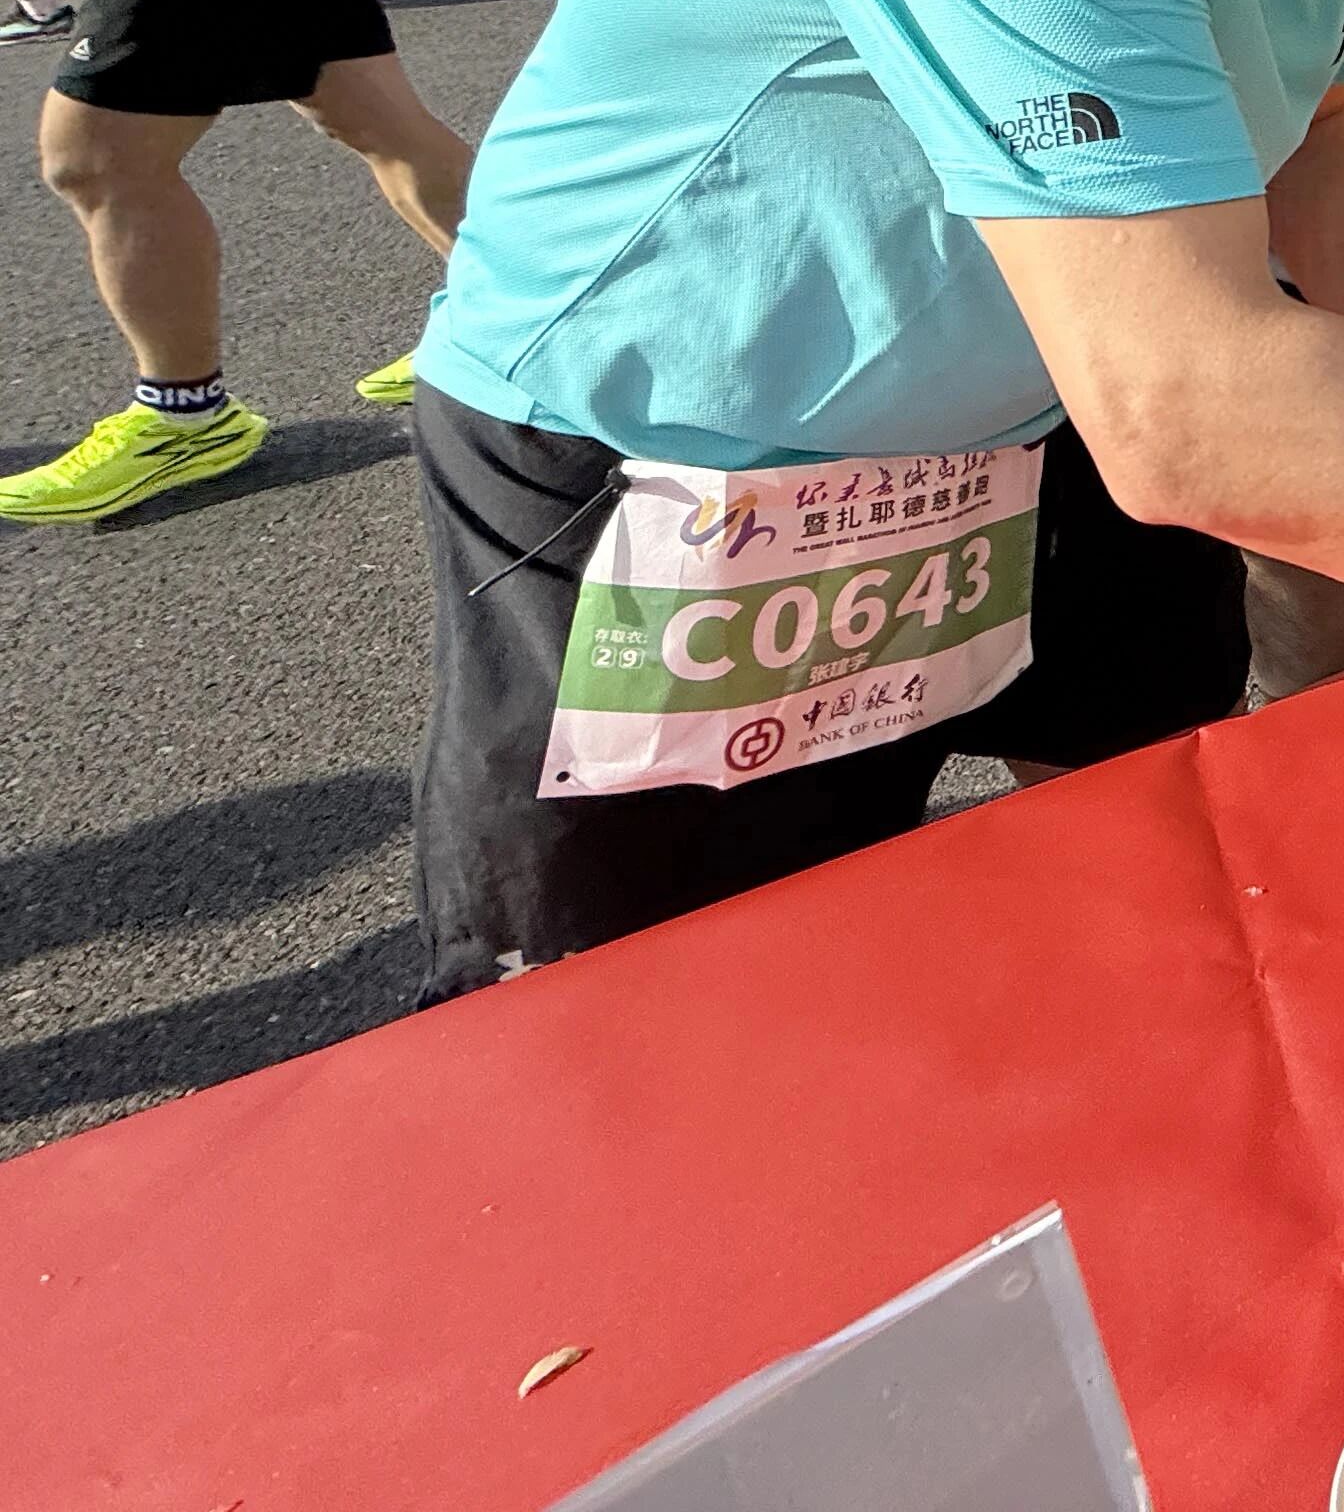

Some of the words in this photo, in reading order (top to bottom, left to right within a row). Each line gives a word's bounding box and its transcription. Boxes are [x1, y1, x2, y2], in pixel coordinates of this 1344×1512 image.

[1016, 93, 1066, 117] THE
[984, 110, 1069, 140] NORTH
[1008, 129, 1071, 156] FACE
[661, 536, 993, 682] C0643
[798, 727, 846, 752] BANK
[848, 720, 871, 737] OF
[873, 708, 926, 730] CHINA
